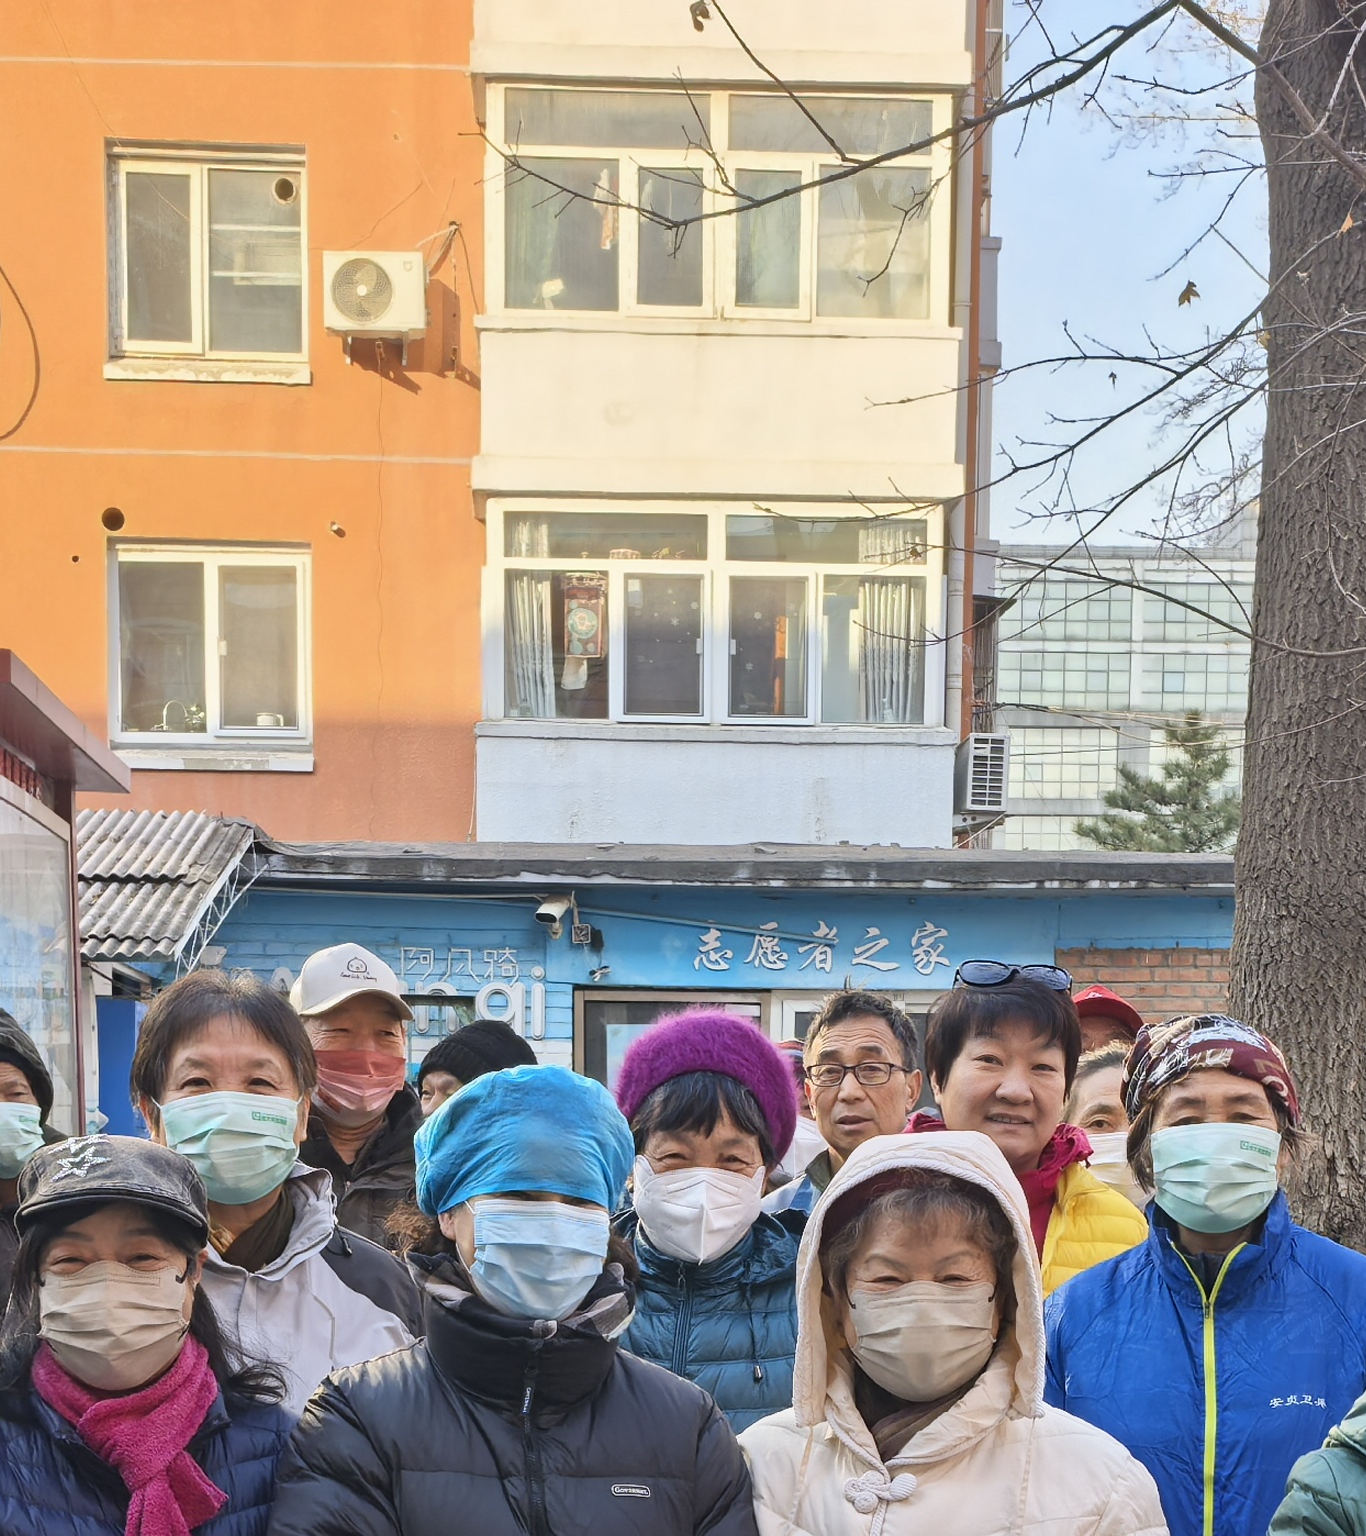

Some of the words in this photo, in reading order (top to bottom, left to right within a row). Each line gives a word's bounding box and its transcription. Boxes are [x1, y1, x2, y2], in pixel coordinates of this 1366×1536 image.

[693, 921, 951, 975] 志愿者之家
